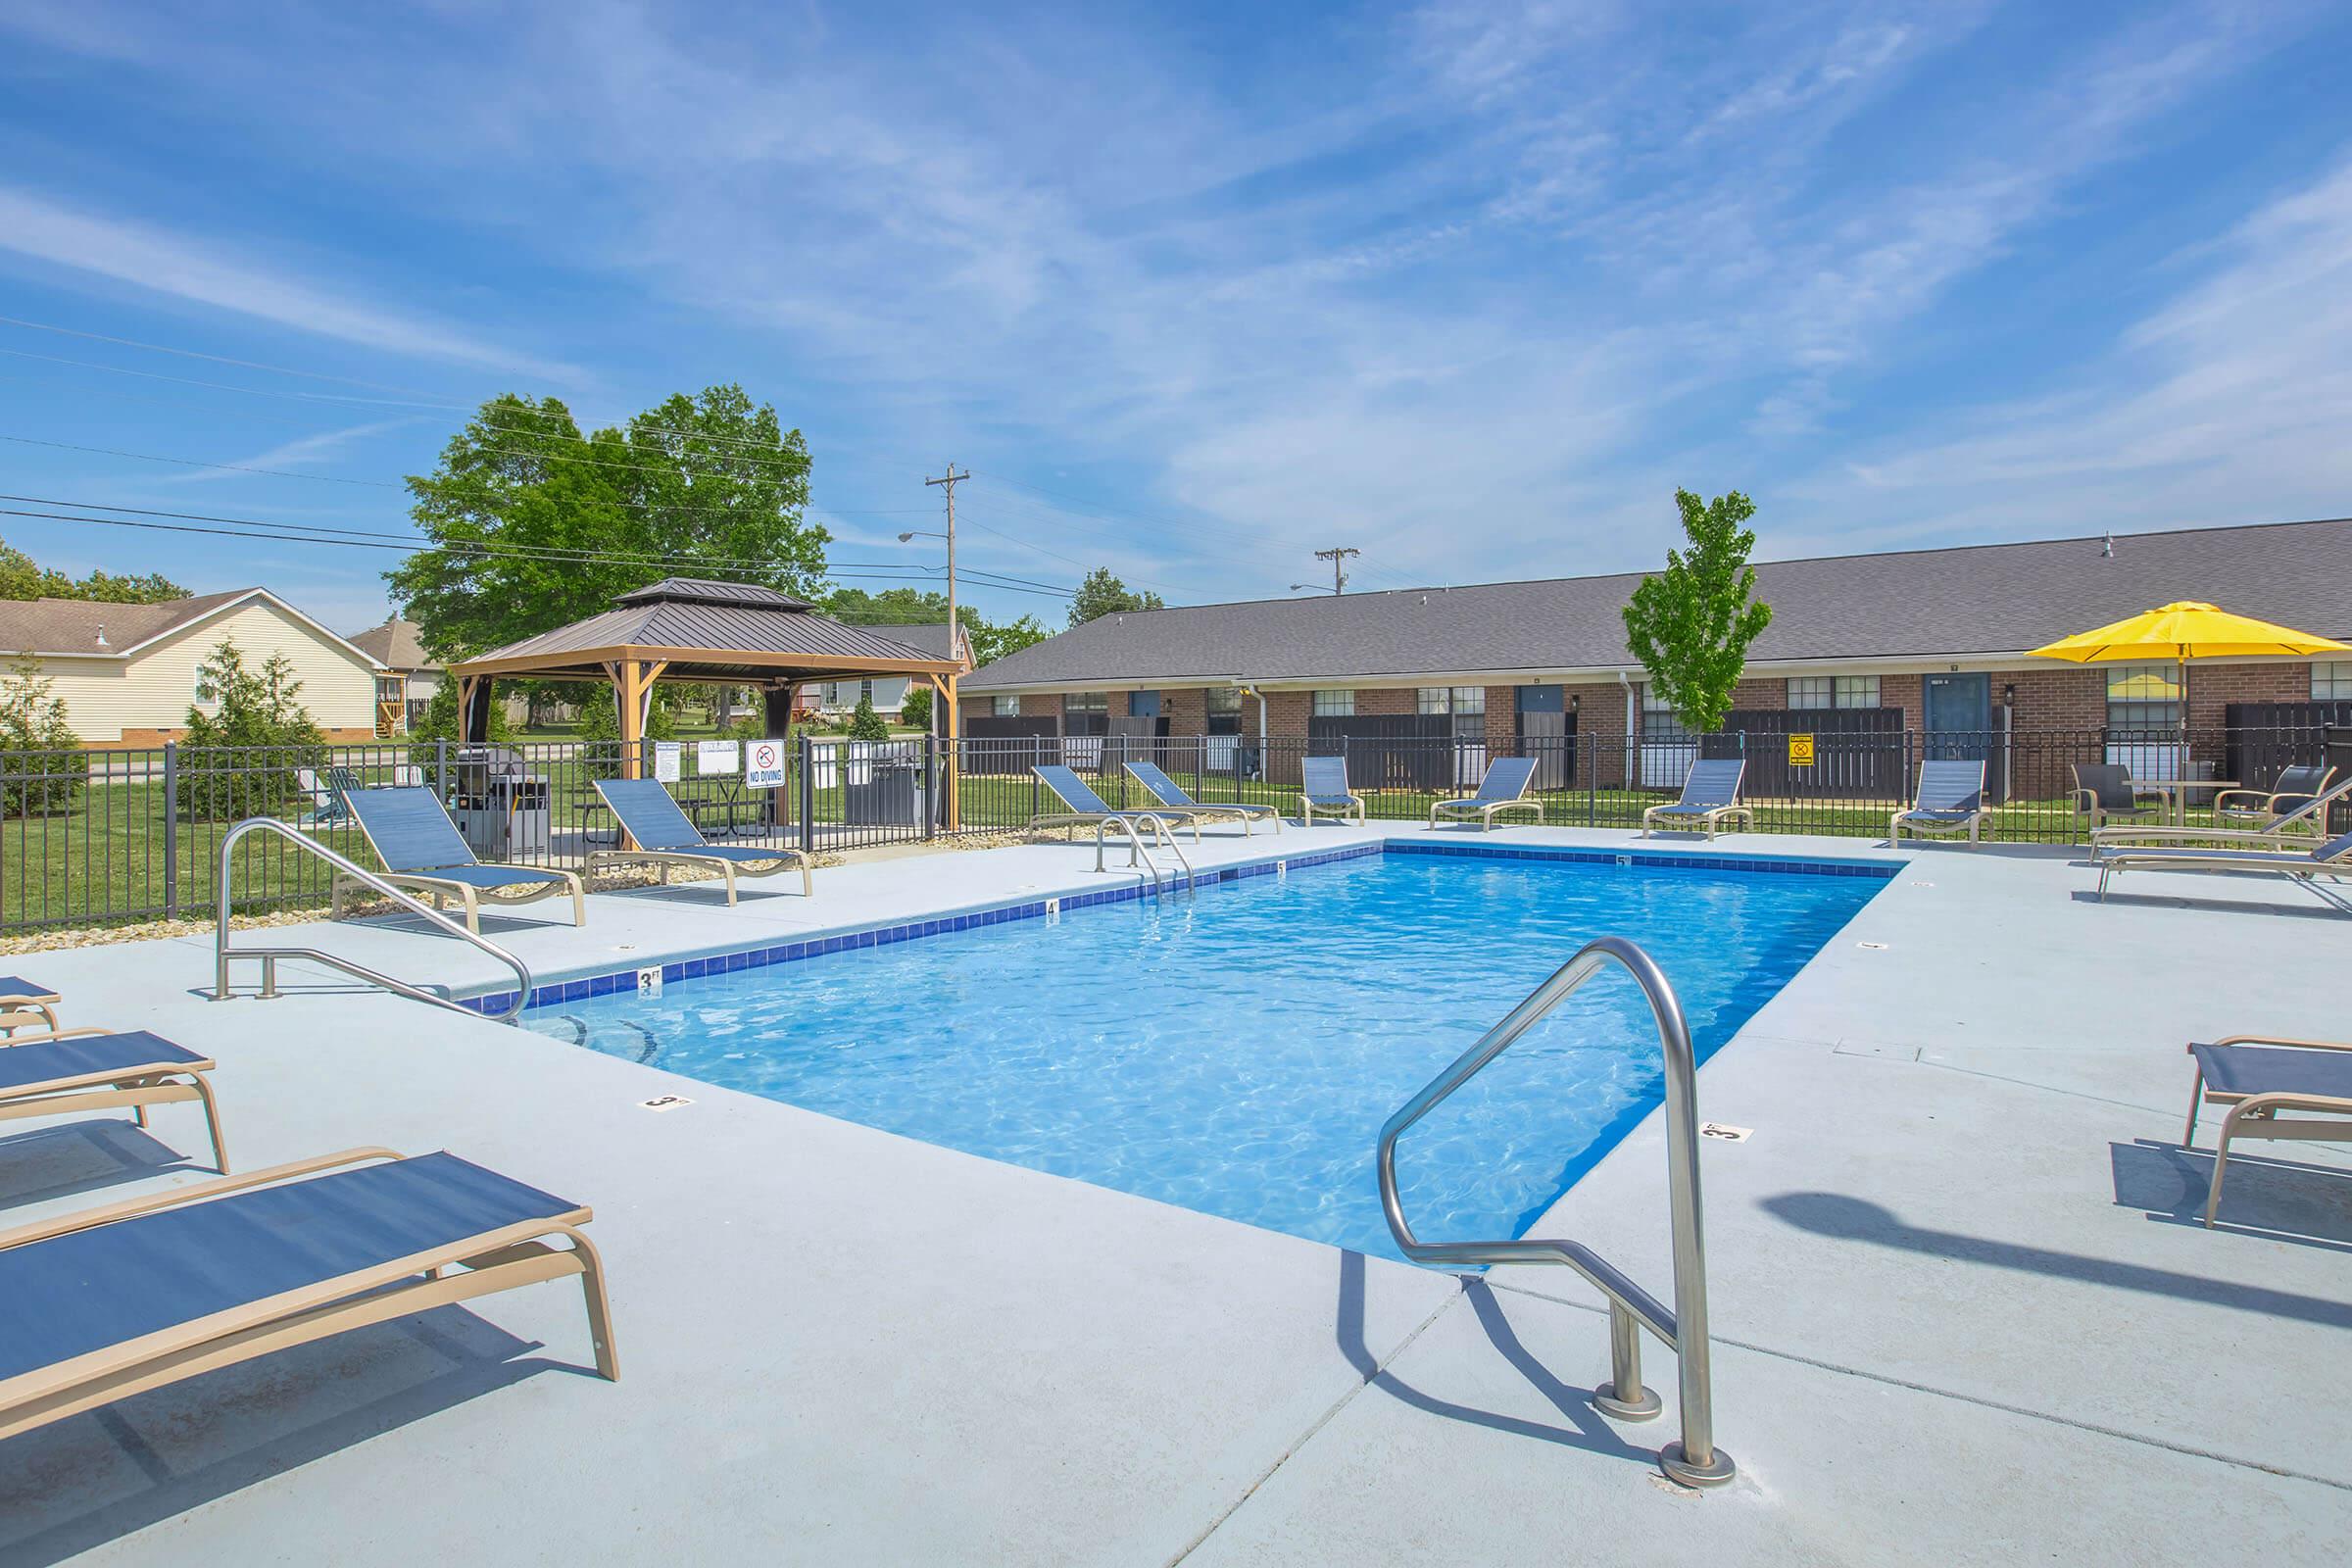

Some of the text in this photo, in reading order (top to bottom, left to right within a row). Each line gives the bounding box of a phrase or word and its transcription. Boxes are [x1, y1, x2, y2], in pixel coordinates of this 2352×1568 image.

[750, 769, 782, 782] NO DIVING
[1048, 902, 1054, 913] 4
[641, 970, 661, 988] 3 FT
[1702, 1129, 1740, 1140] 3
